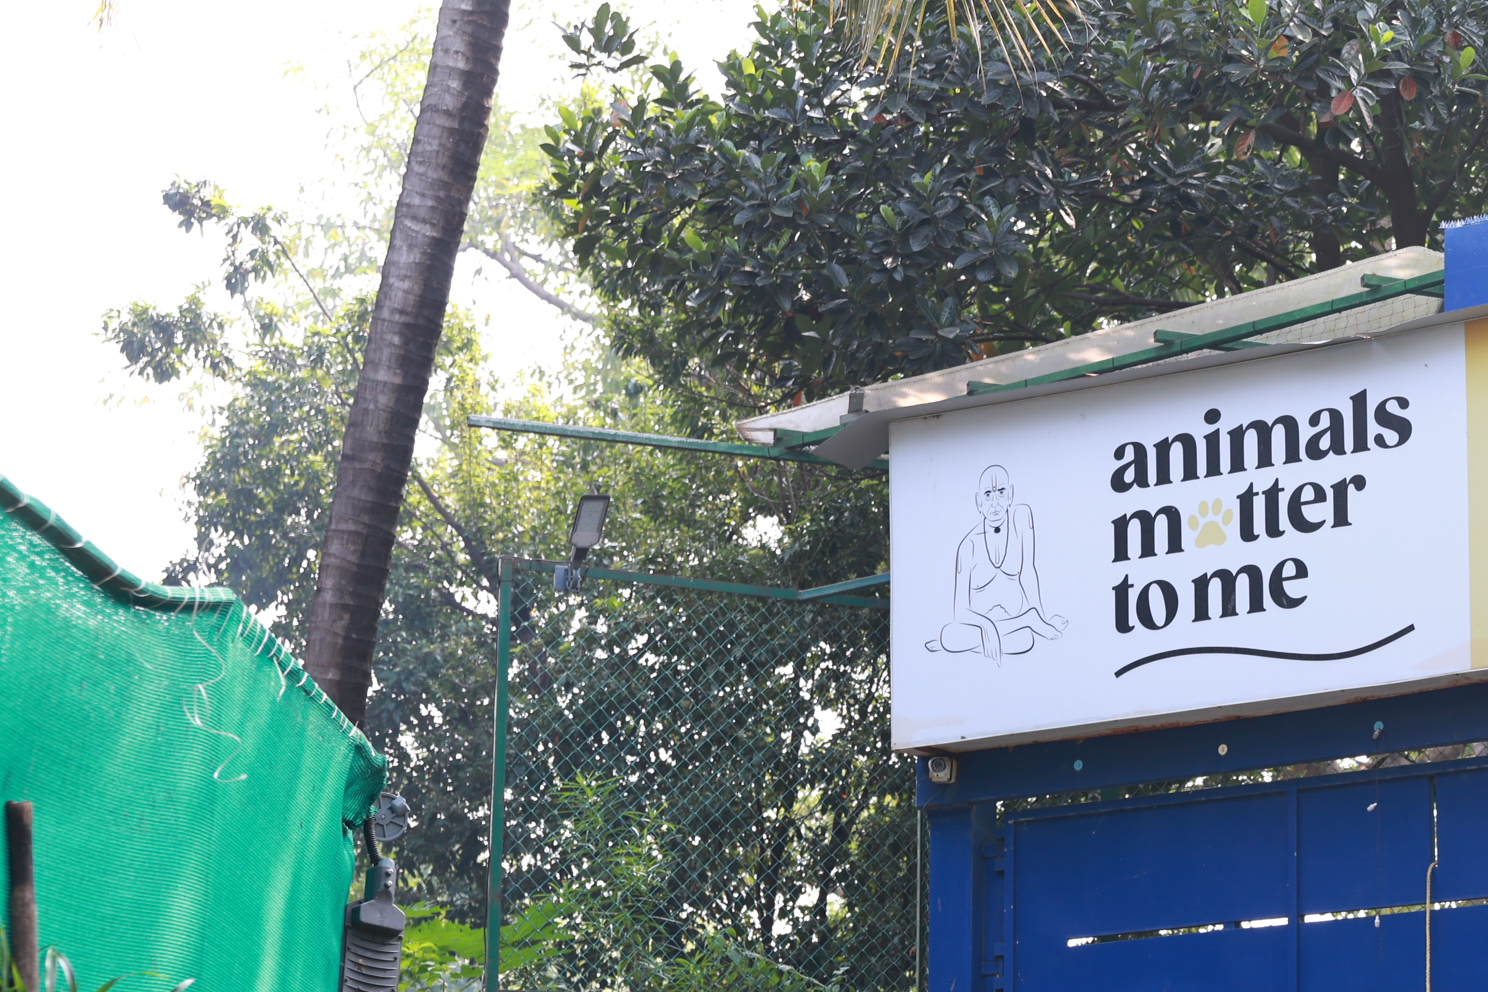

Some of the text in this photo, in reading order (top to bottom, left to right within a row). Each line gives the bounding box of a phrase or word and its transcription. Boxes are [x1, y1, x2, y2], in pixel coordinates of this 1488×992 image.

[1110, 388, 1412, 493] animals
[1111, 475, 1366, 563] mtter
[1112, 558, 1308, 634] to me
